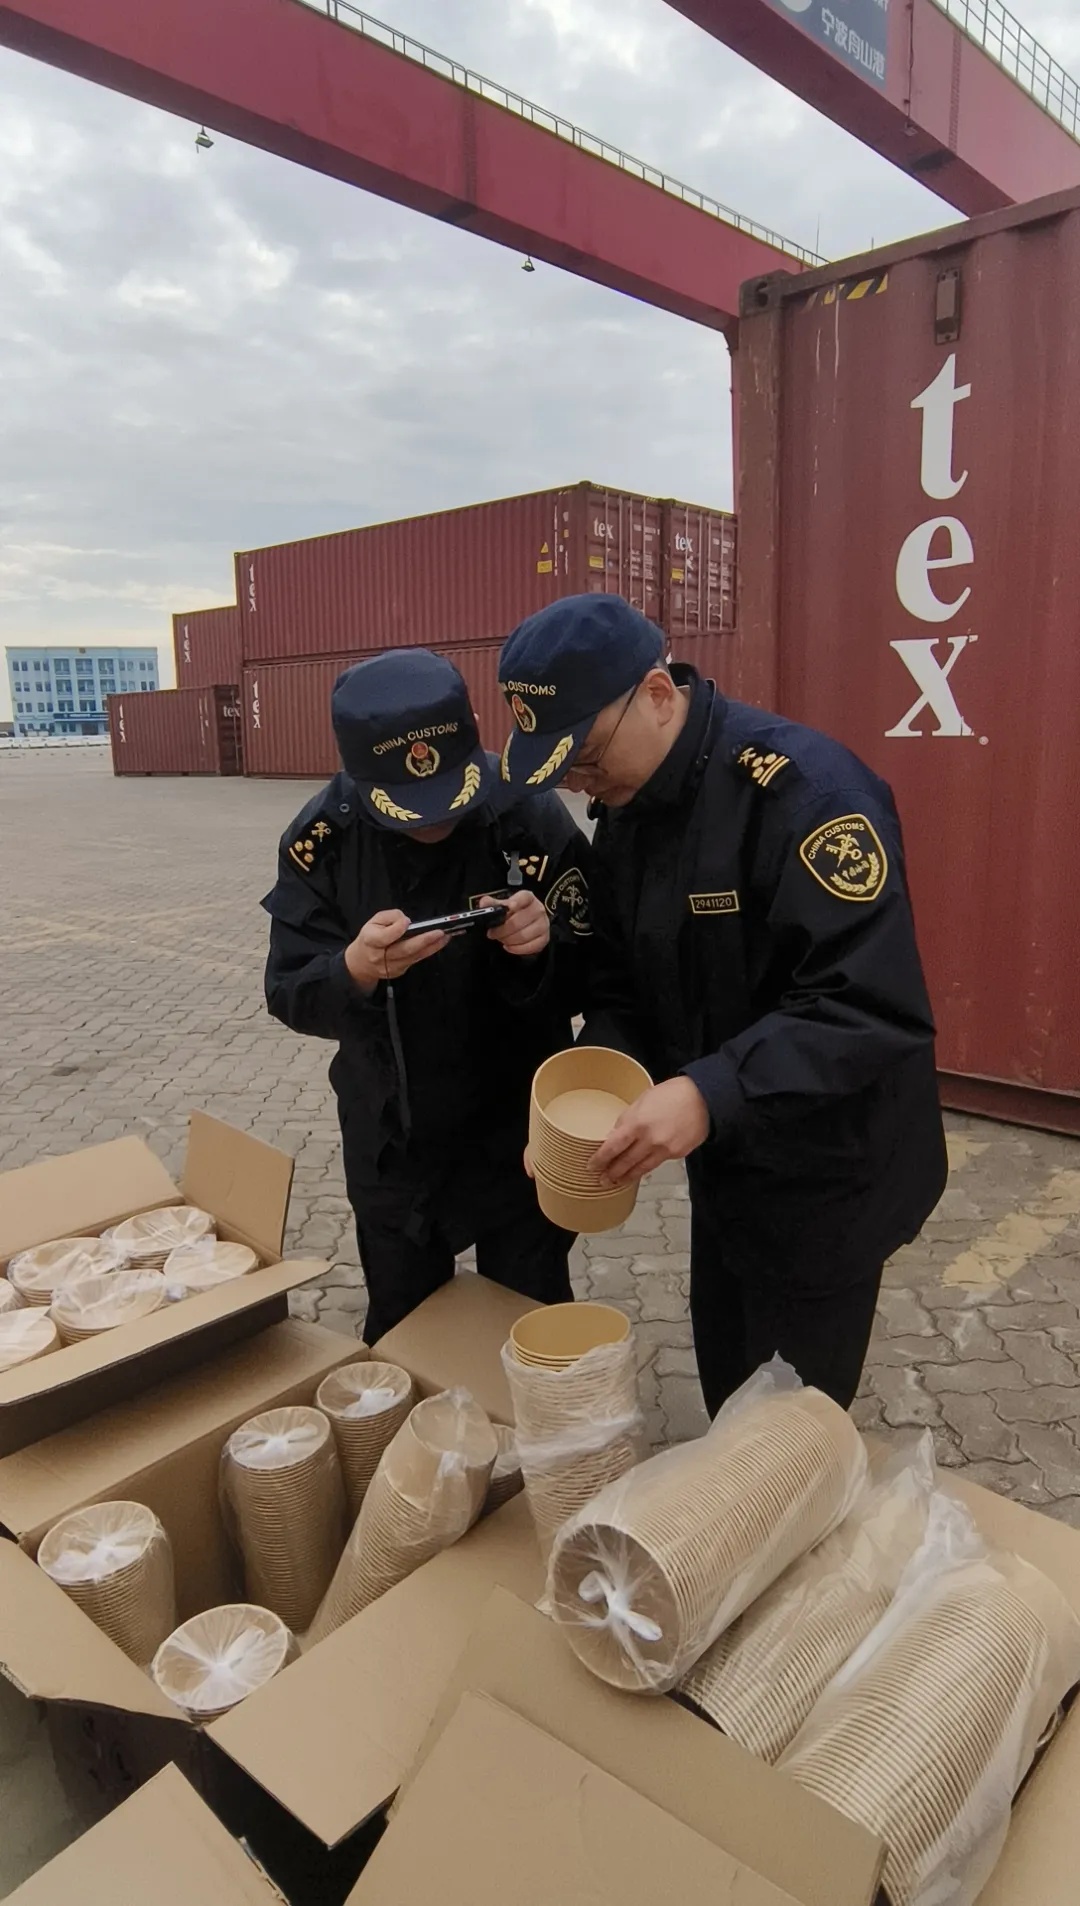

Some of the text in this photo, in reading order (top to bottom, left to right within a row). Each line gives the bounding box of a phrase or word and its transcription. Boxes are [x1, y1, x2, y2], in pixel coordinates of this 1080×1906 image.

[821, 7, 886, 80] 宁波舟山港
[593, 517, 614, 540] tex
[675, 532, 693, 552] tex
[885, 353, 979, 738] tex
[249, 564, 257, 612] tex
[252, 681, 261, 729] tex
[507, 680, 557, 696] CUSTOMS
[372, 722, 459, 756] CHINA CUSTOMS
[808, 822, 865, 860] CHINA CUSTOMS
[695, 896, 733, 909] 2941120
